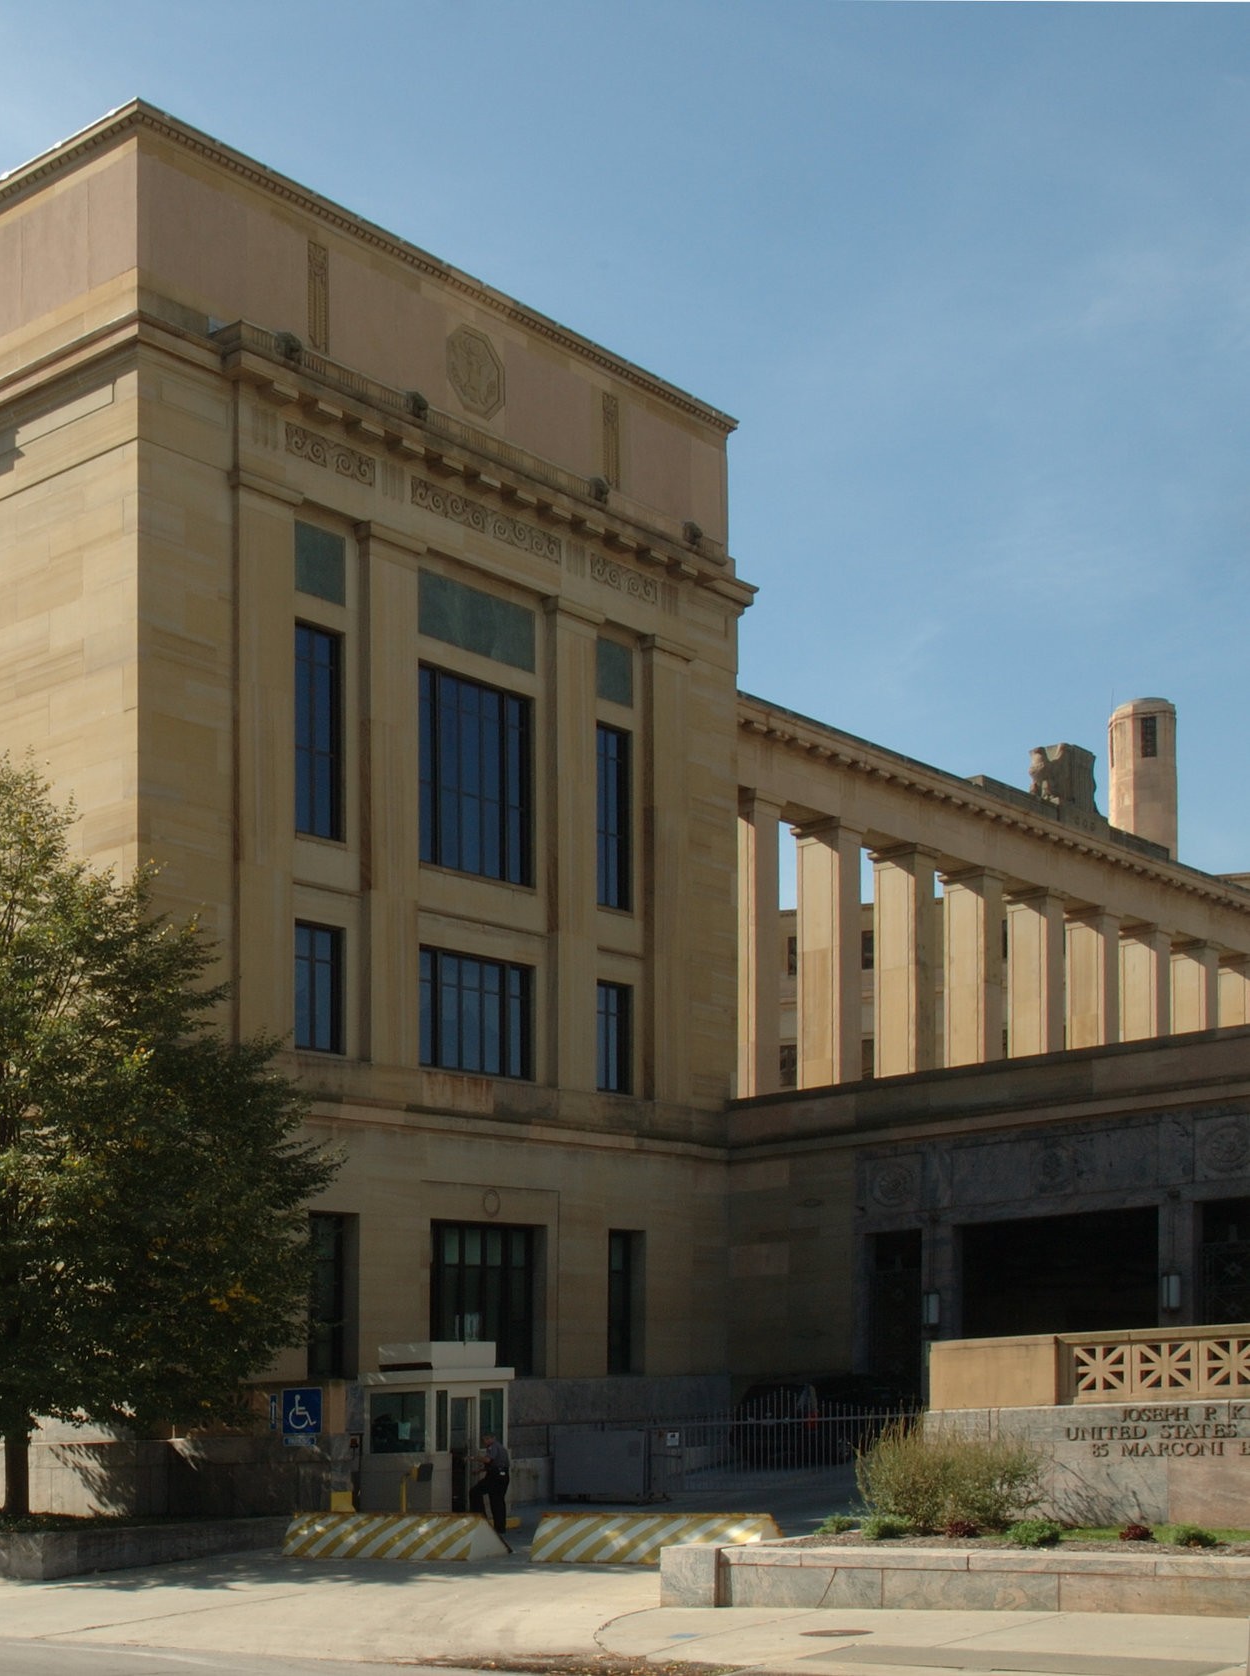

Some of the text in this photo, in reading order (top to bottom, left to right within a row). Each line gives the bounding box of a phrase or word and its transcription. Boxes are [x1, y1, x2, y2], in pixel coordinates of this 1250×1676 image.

[1121, 1407, 1190, 1423] JOSEPH
[1066, 1424, 1237, 1441] UNITED STATES
[1092, 1443, 1110, 1457] 85
[1121, 1442, 1225, 1457] MARCONI
